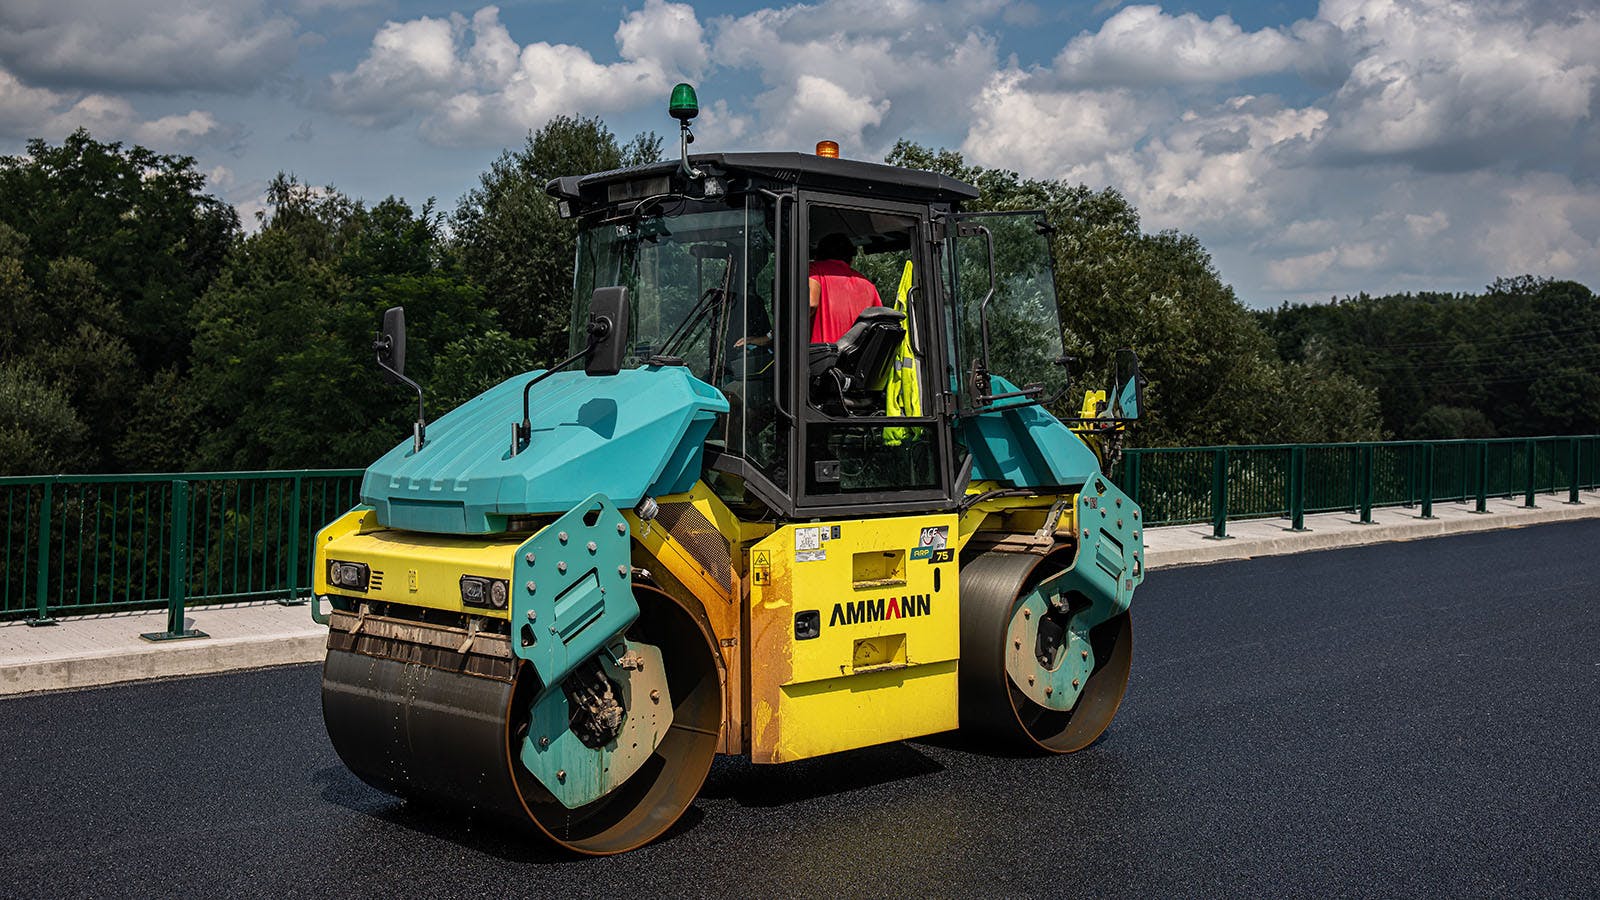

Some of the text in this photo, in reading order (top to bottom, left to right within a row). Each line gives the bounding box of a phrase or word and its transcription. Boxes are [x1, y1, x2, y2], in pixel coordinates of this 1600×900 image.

[921, 528, 938, 539] ACE
[913, 549, 949, 561] ARP 75
[829, 594, 930, 627] AMMANN
